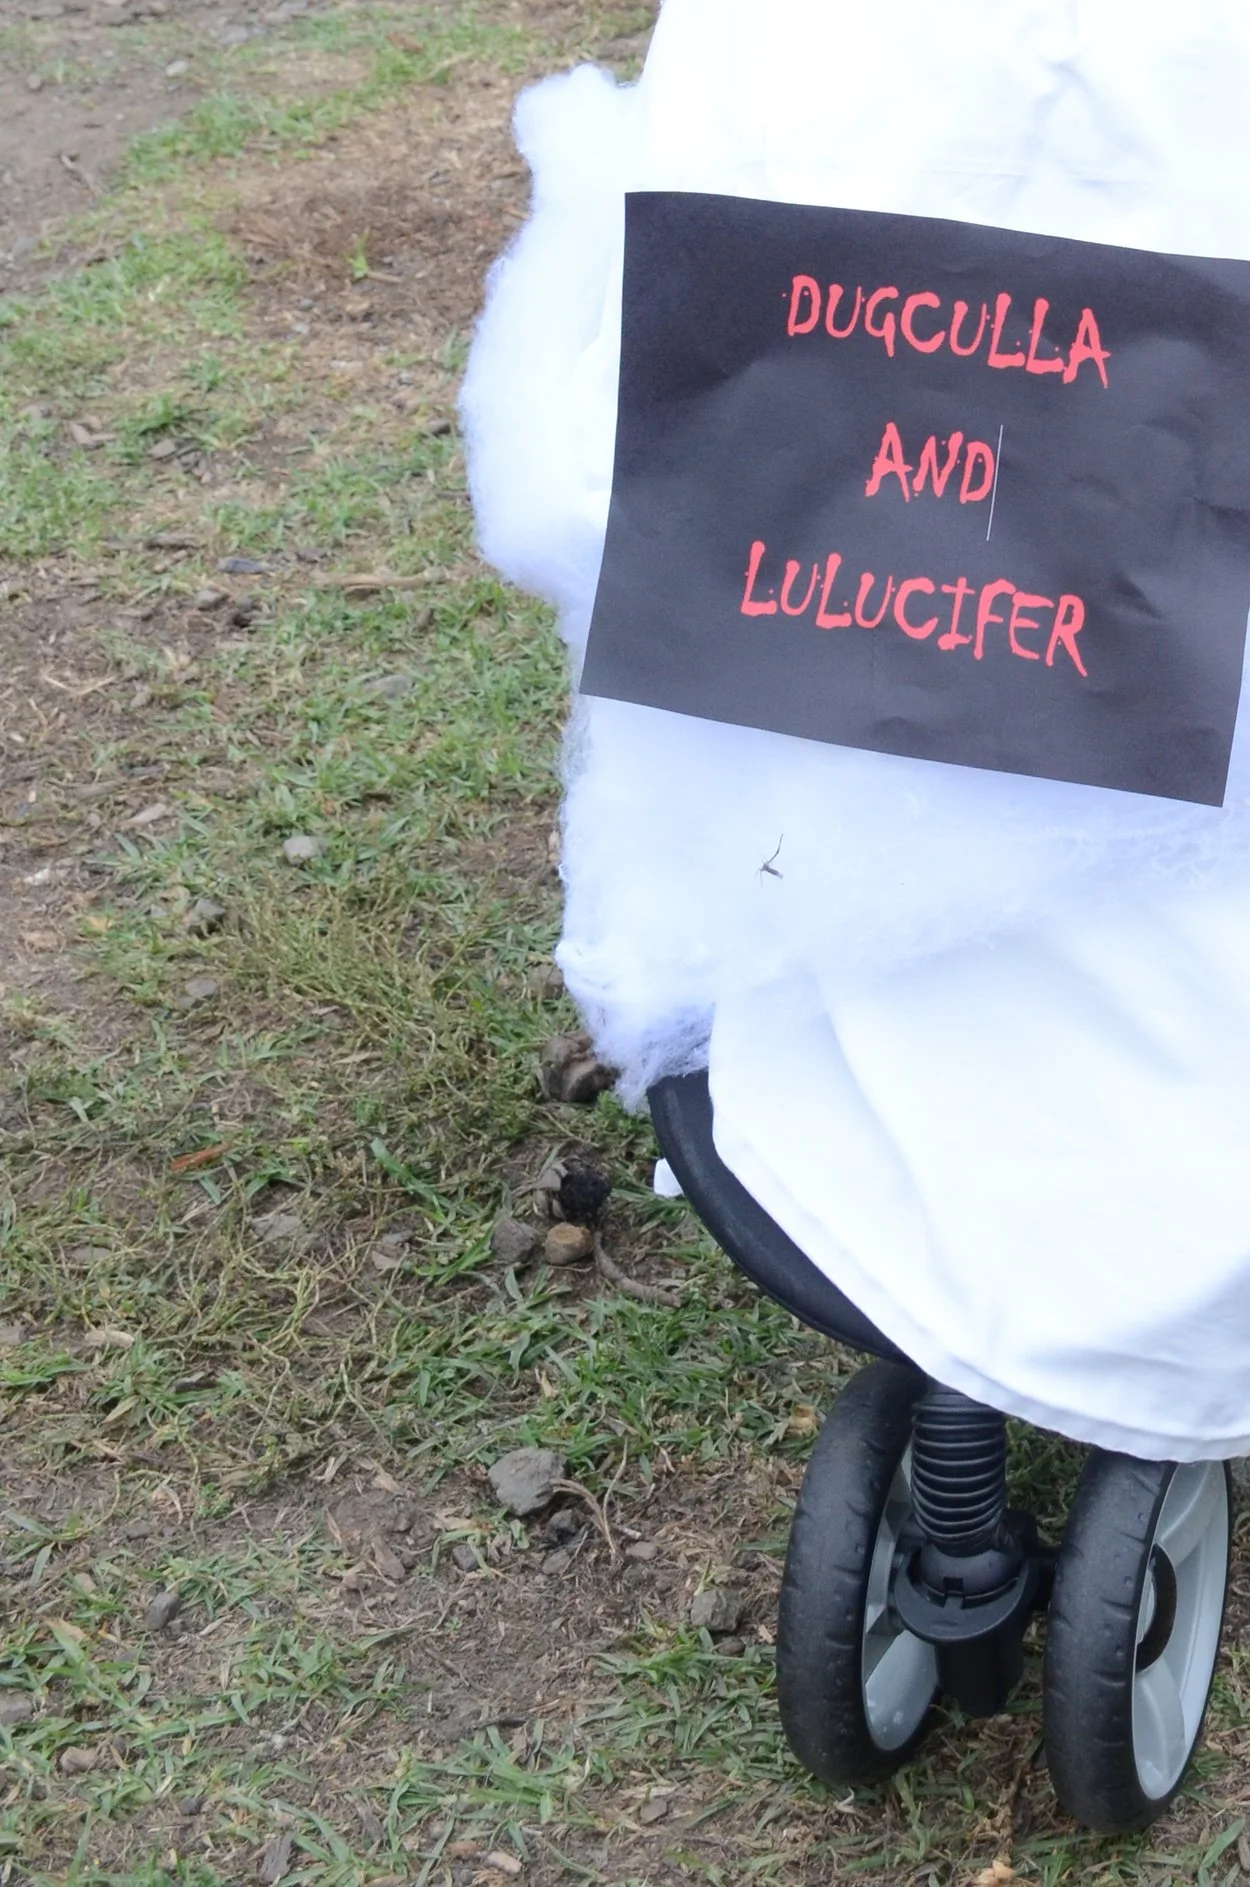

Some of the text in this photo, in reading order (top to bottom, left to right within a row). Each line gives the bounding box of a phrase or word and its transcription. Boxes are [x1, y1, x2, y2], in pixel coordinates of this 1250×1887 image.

[787, 275, 1111, 388] DUGCULLA
[866, 423, 994, 501] AND
[741, 541, 1087, 676] LULUCIFER
